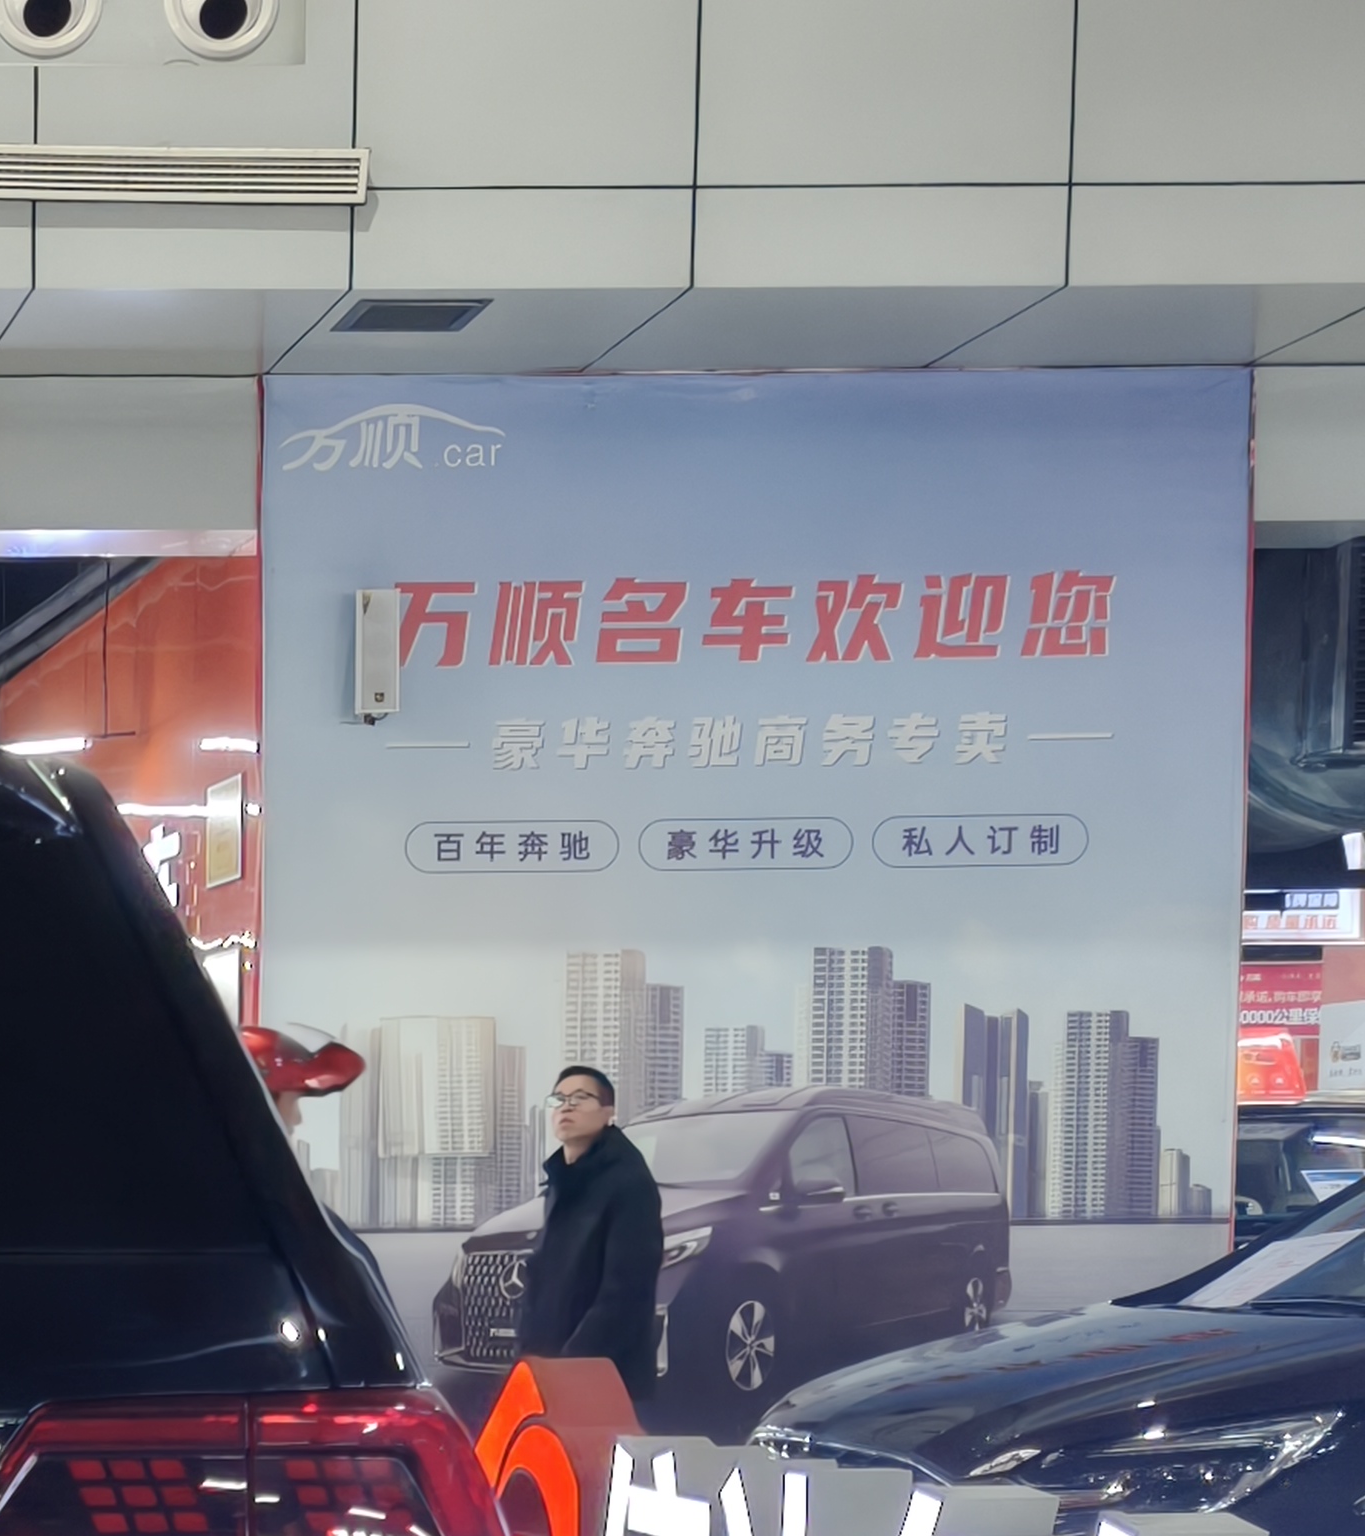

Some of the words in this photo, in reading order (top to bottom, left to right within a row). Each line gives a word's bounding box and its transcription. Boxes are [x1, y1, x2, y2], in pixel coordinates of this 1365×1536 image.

[395, 571, 1118, 668] 万顺名车欢迎您
[491, 712, 1011, 771] 豪华奔驰商务专卖
[432, 829, 593, 865] 百年奔驰
[666, 826, 826, 862] 豪华升级
[901, 822, 1062, 859] 私人订制
